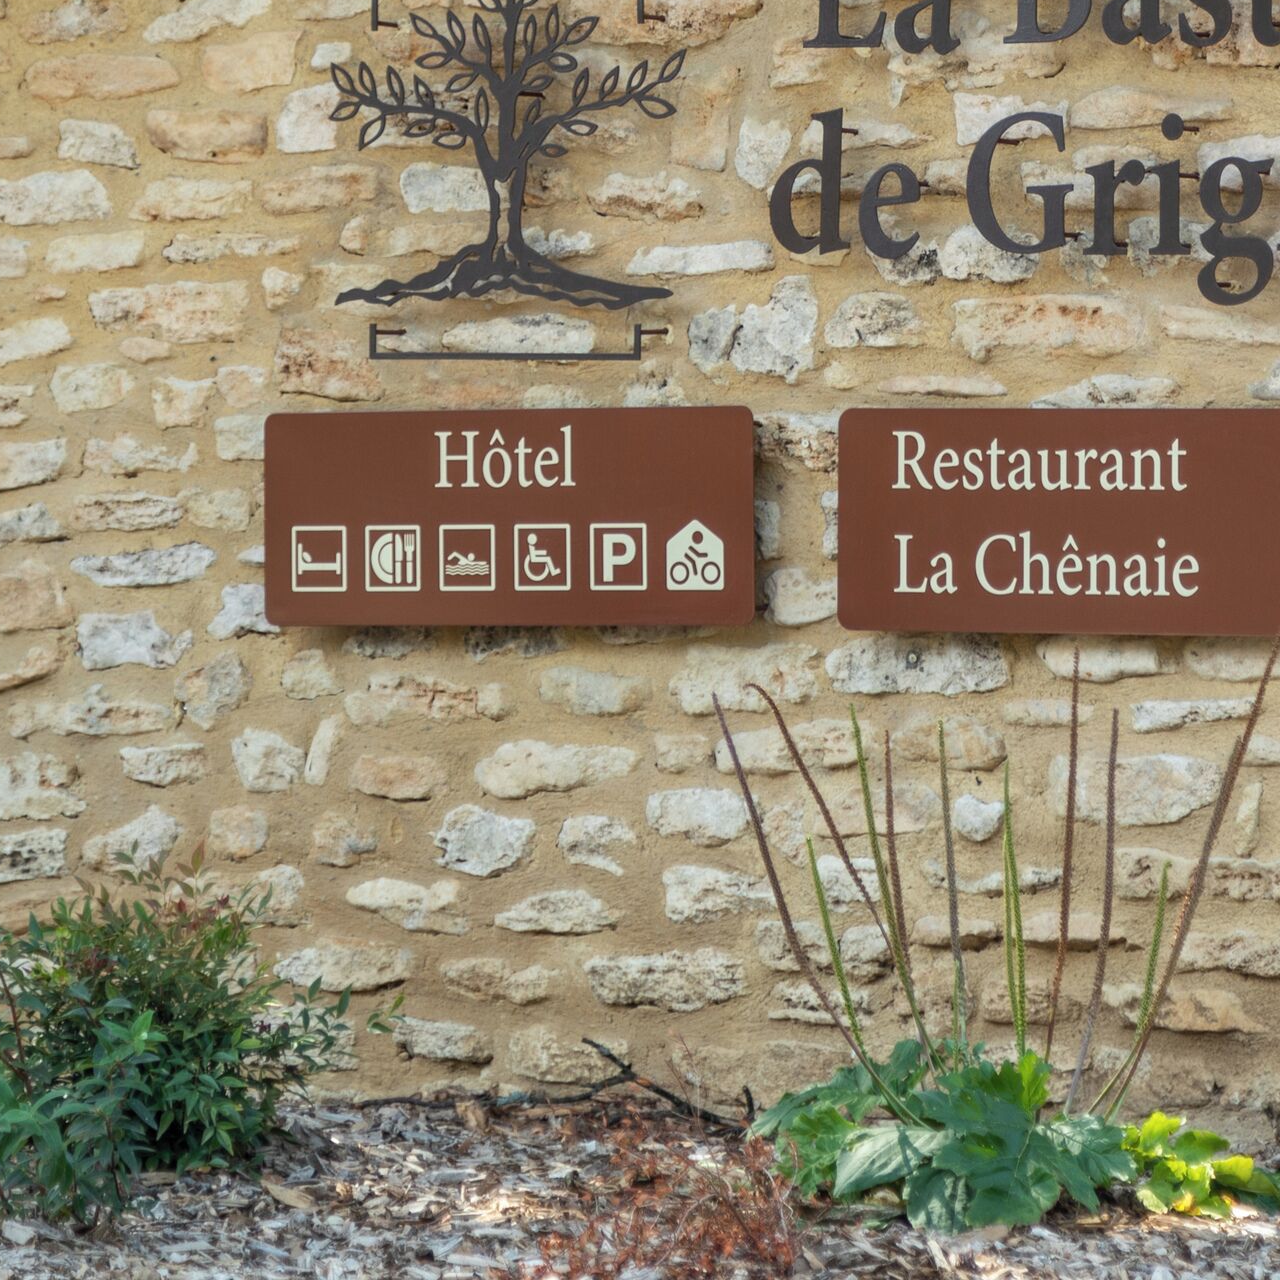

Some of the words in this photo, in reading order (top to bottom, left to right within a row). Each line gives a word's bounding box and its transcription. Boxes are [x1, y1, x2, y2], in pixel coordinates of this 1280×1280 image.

[769, 108, 920, 259] de
[434, 425, 576, 488] Hôtel
[892, 430, 1187, 492] Restaurant
[893, 534, 958, 595] La
[975, 531, 1200, 597] Chênaie
